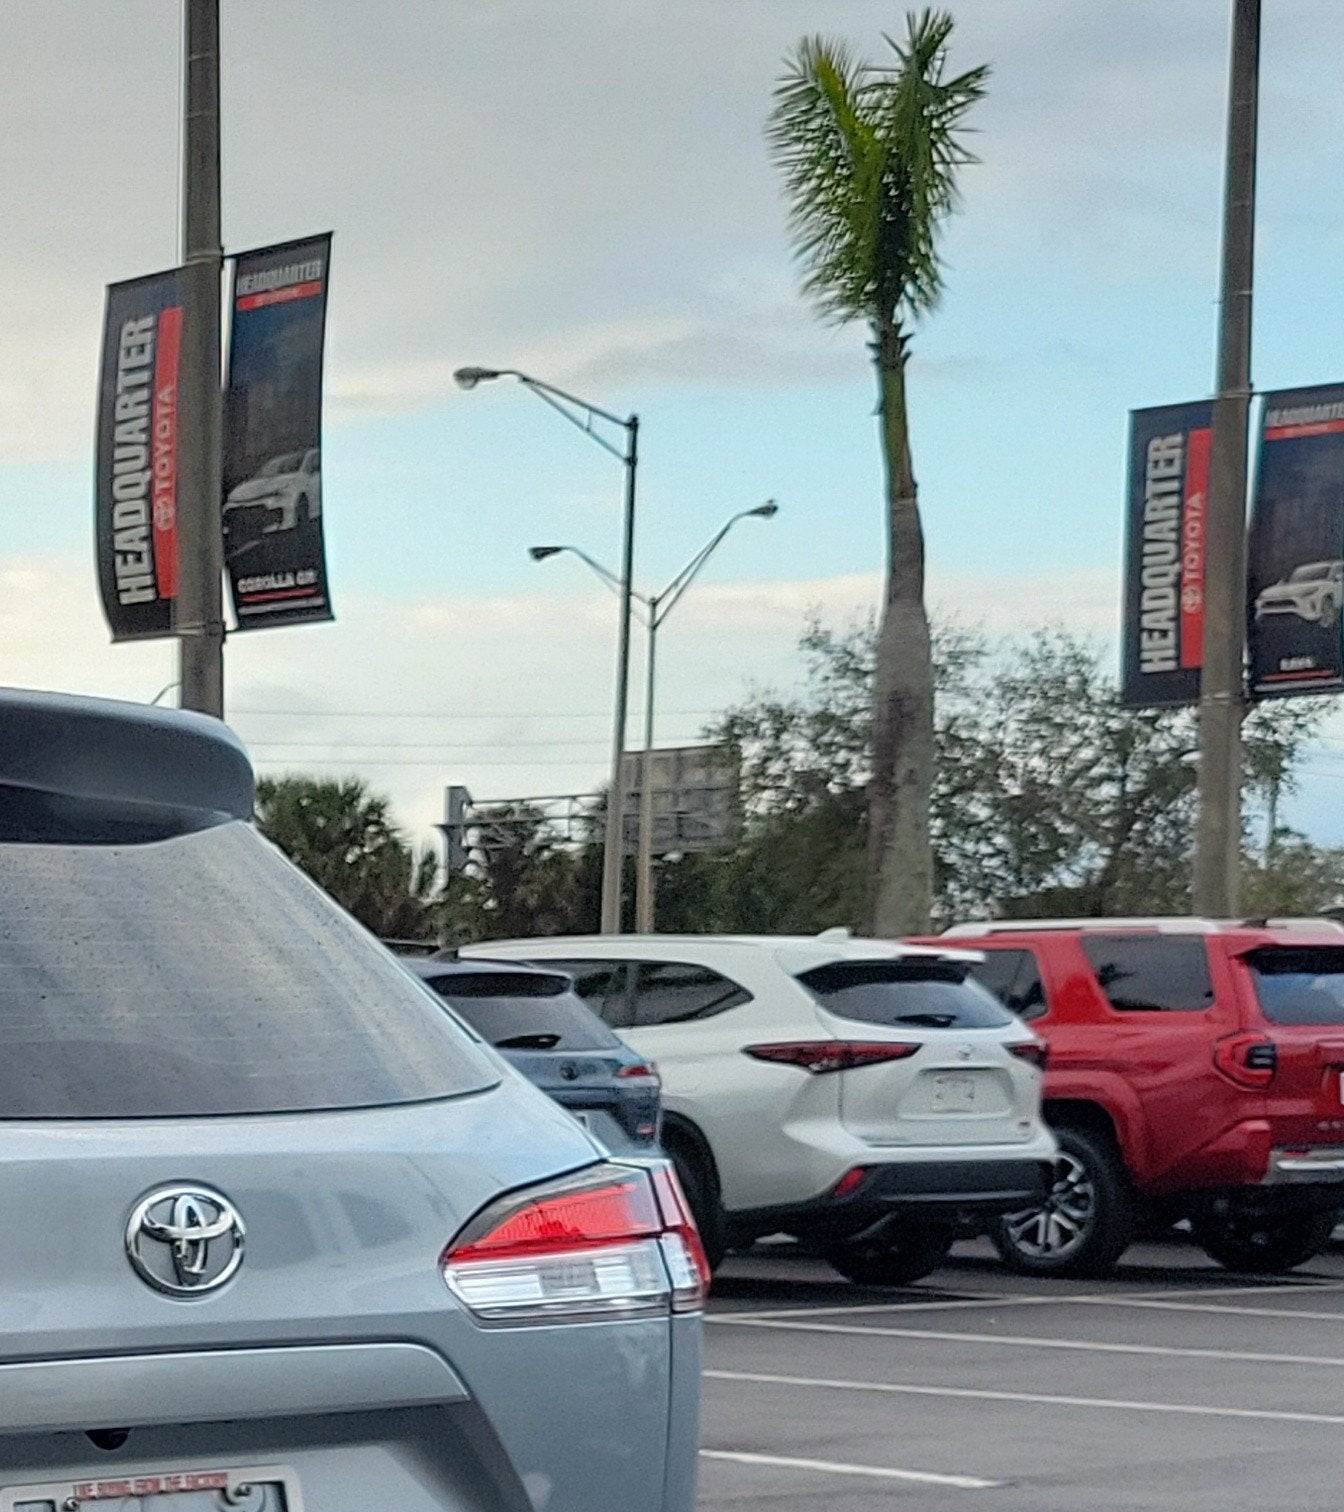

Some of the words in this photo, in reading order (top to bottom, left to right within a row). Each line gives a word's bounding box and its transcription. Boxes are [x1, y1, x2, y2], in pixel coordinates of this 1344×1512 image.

[113, 314, 157, 606] HEADQUARTER
[153, 385, 176, 495] TOYOTA
[1140, 432, 1184, 673] HEADQUARTER
[1182, 491, 1205, 580] TOYOTA
